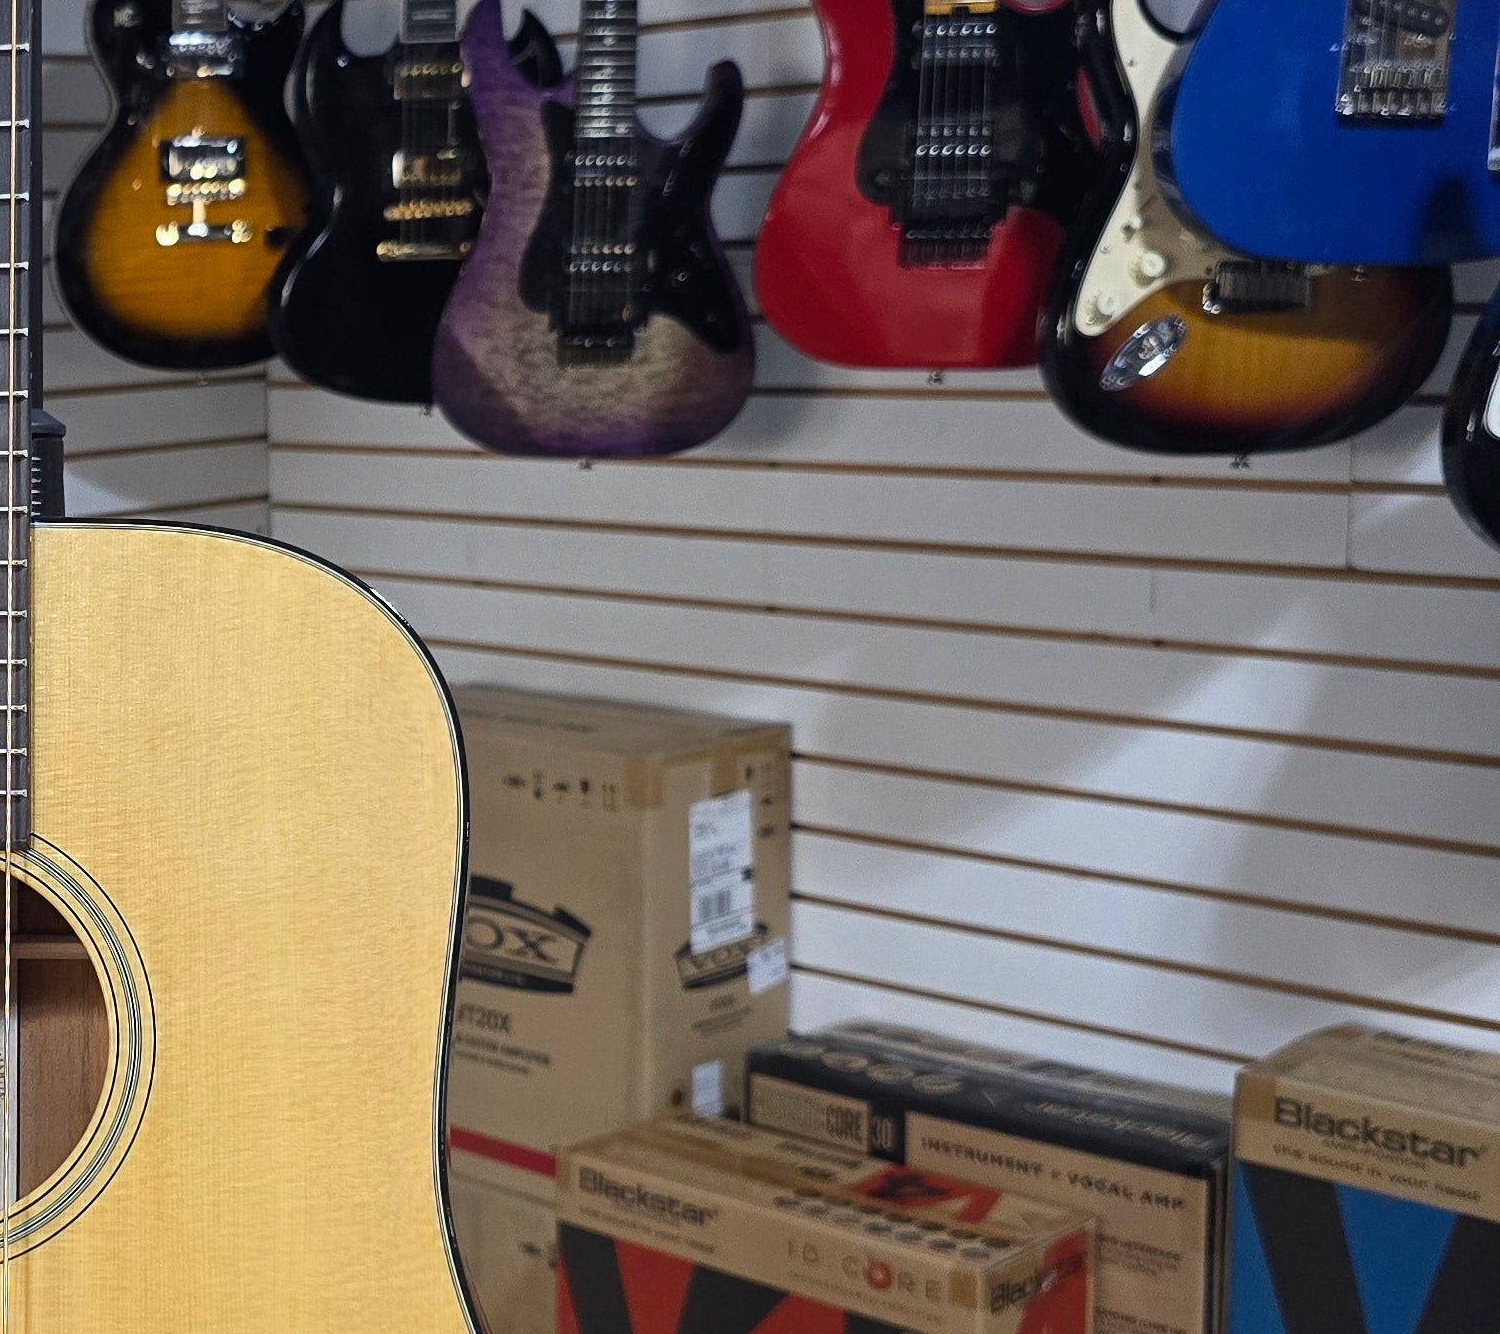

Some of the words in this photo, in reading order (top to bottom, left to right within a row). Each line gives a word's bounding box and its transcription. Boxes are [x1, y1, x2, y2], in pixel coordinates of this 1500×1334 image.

[466, 917, 558, 964] OX
[457, 1004, 511, 1035] T20X
[870, 1116, 894, 1151] 30
[1273, 1095, 1482, 1170] Blackstar
[579, 1165, 715, 1228] Blackstar
[920, 1136, 1044, 1177] INSTRUMENT
[1067, 1171, 1134, 1202] VOCAL
[1138, 1190, 1187, 1212] AMP
